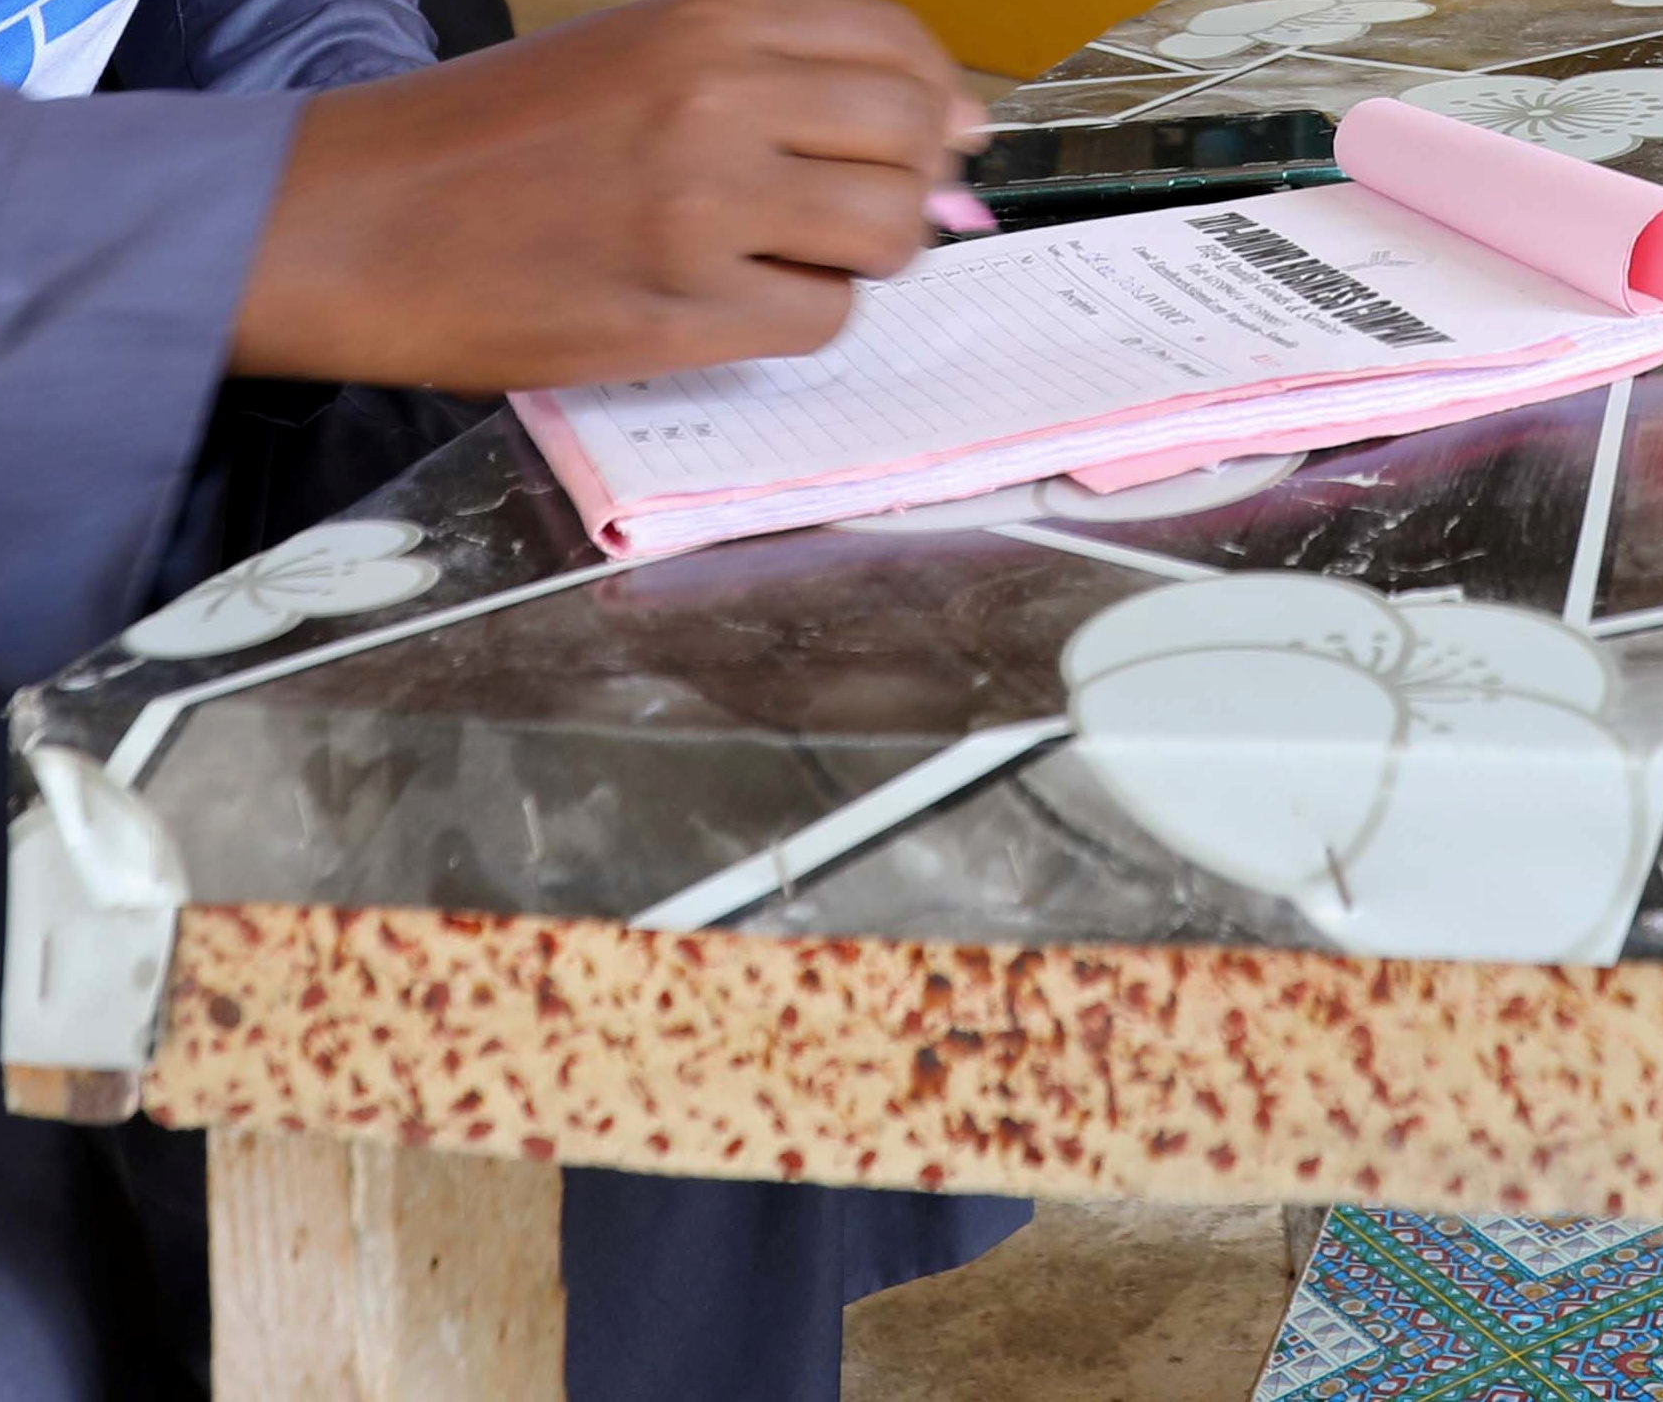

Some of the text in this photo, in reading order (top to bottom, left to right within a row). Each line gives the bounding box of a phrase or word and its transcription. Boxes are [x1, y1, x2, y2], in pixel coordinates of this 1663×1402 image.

[1135, 291, 1196, 326] INVOICE
[1262, 259, 1380, 310] BUSINESS
[1331, 300, 1457, 348] COMPANY
